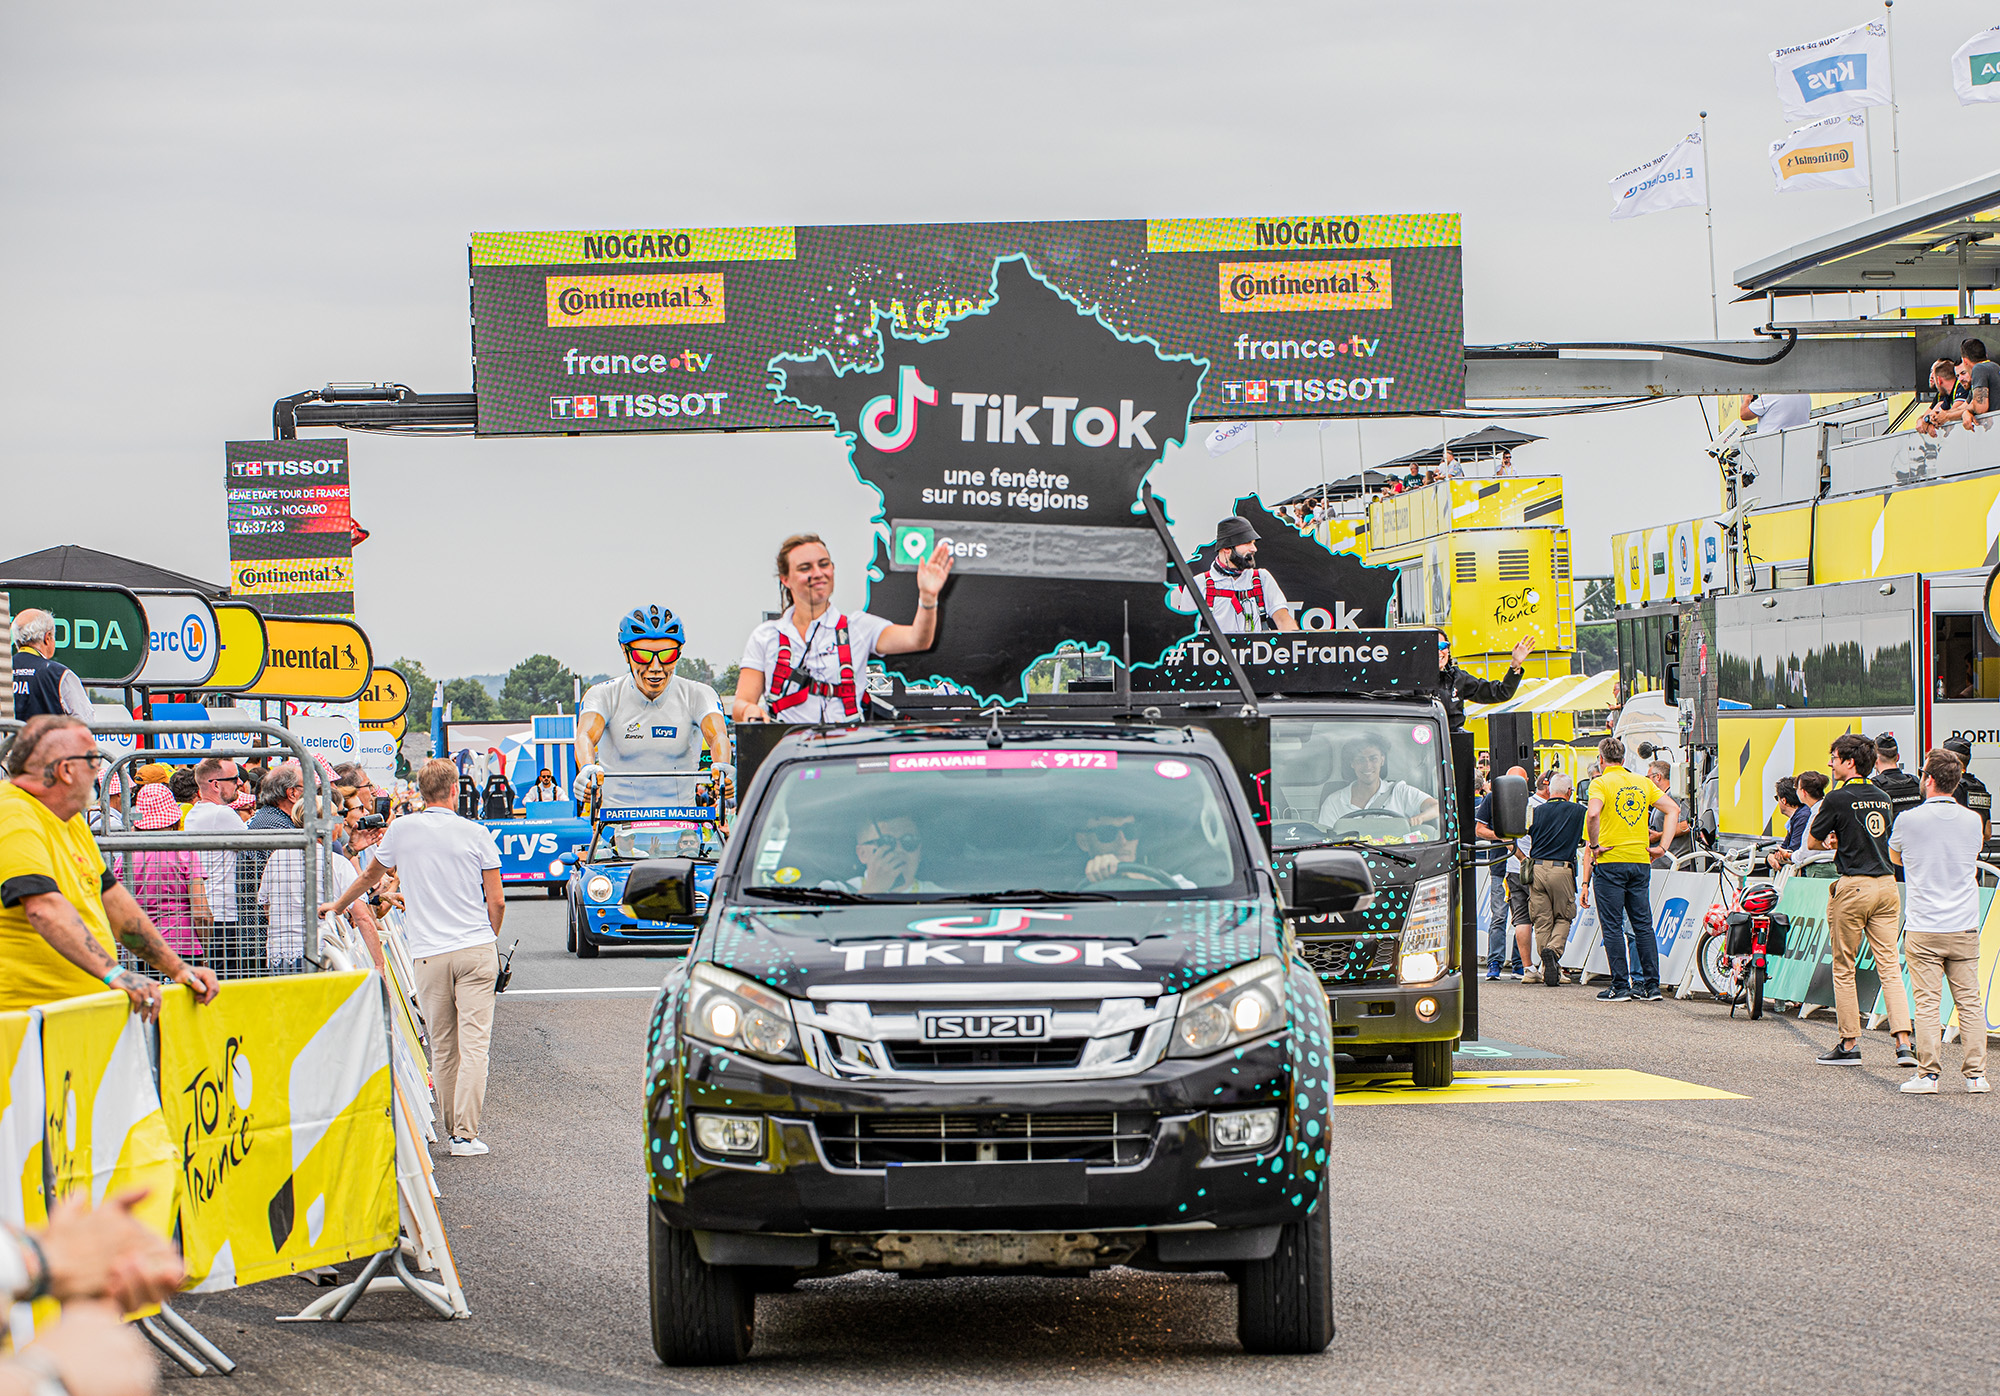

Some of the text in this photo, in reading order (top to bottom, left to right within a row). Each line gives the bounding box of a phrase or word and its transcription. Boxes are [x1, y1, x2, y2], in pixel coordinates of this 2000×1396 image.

[1256, 221, 1360, 246] NOGARO
[583, 234, 691, 259] NOGARO
[1230, 272, 1359, 301] Continental
[558, 286, 690, 316] Continental
[1270, 376, 1395, 402] TISSOT
[600, 392, 728, 418] TISSOT
[951, 392, 1157, 450] TikTok
[263, 459, 344, 476] TISSOT
[943, 467, 1070, 490] une fenêtre
[253, 490, 278, 500] ETAPE
[279, 489, 302, 499] TOUR
[303, 489, 314, 499] DE
[316, 488, 349, 498] FRANCE
[922, 487, 1089, 512] sur nos régions
[252, 506, 272, 516] DAX
[282, 504, 327, 515] NOGARO
[234, 520, 286, 534] 16:37:23
[238, 567, 330, 587] Continental
[655, 728, 674, 737] Krys
[896, 755, 987, 768] CARAVANE
[1054, 753, 1107, 767] 9172
[606, 809, 708, 819] PARTENAIRE MAJEUR
[1851, 801, 1891, 810] CENTURY
[1870, 819, 1880, 830] 21
[489, 828, 559, 861] Krys
[830, 939, 1142, 971] TikTok
[927, 1015, 1044, 1038] ISUZU
